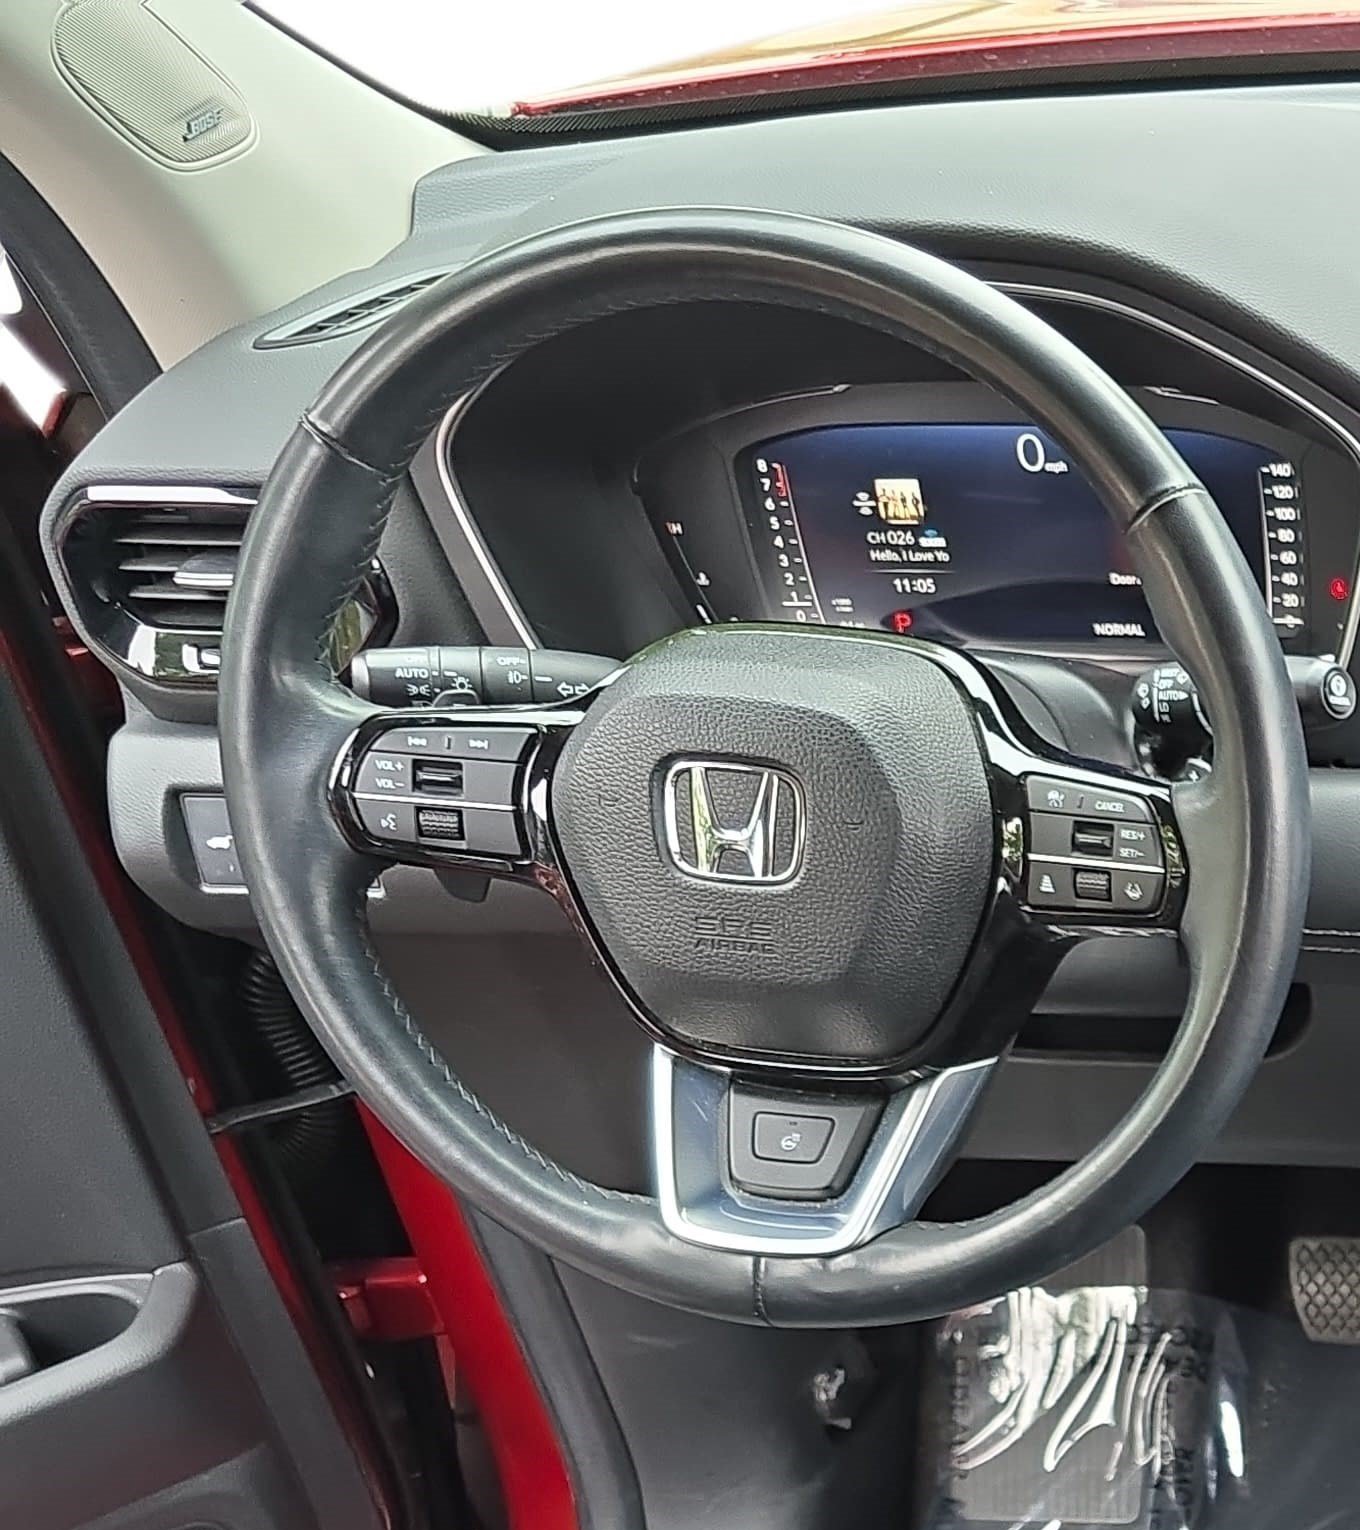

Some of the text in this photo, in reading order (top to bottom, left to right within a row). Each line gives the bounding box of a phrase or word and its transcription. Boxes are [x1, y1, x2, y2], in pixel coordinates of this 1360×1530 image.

[1016, 433, 1046, 473] 0
[757, 459, 768, 473] 8
[1269, 463, 1292, 477] 140
[760, 478, 770, 491] 7
[1272, 485, 1294, 499] 120
[765, 497, 775, 511] 6
[1275, 507, 1296, 521] 100
[769, 517, 780, 530] 5
[774, 535, 784, 549] 4
[866, 531, 886, 544] CH
[887, 531, 915, 545] 026
[779, 554, 789, 567] 3
[870, 550, 902, 564] Hello,
[908, 550, 934, 562] Love
[935, 551, 950, 562] Yo
[1280, 550, 1297, 565] 60
[784, 572, 795, 586] 2
[893, 578, 936, 593] 11:05
[1281, 572, 1298, 587] 40
[790, 591, 799, 603] 1
[1282, 593, 1299, 608] 20
[796, 609, 806, 622] 0
[893, 611, 912, 632] P
[1093, 623, 1145, 637] NORMAL
[394, 667, 429, 679] AUTO
[1095, 801, 1125, 813] CANCEL
